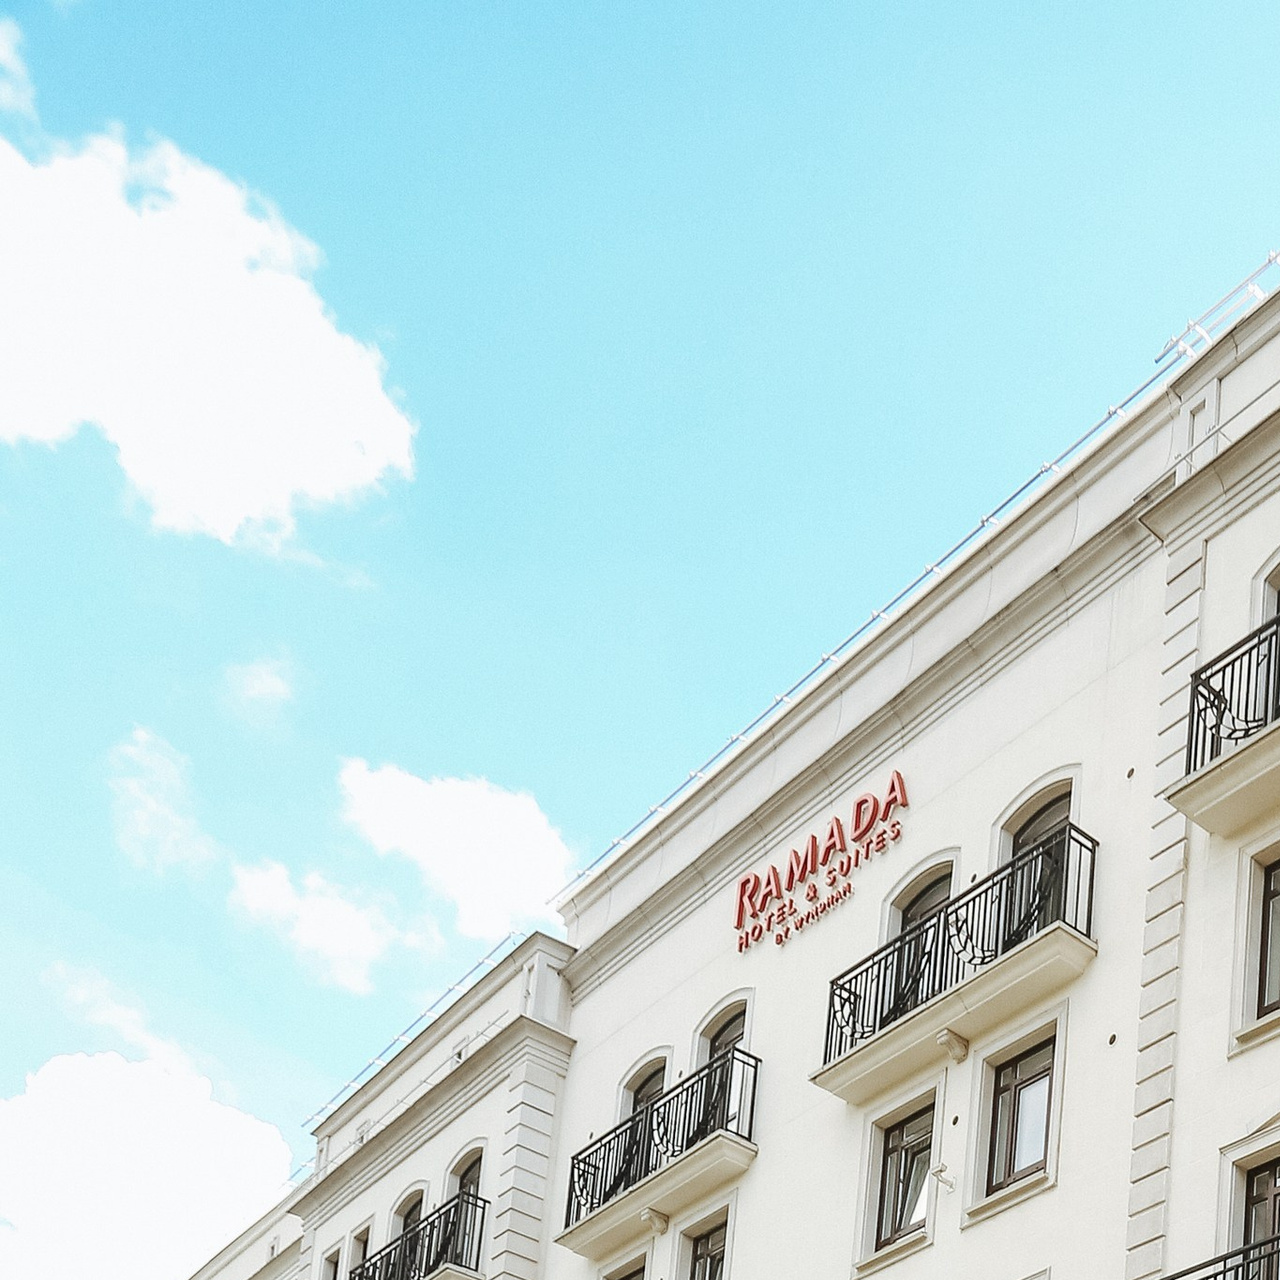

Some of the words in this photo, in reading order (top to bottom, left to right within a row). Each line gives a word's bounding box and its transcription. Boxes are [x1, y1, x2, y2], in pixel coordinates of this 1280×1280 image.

[734, 770, 908, 930] RAMADA
[738, 898, 797, 953] HOTEL
[806, 882, 818, 902] &
[826, 821, 901, 887] SUITES
[776, 926, 790, 945] BY
[794, 882, 852, 931] WYNDHAM
